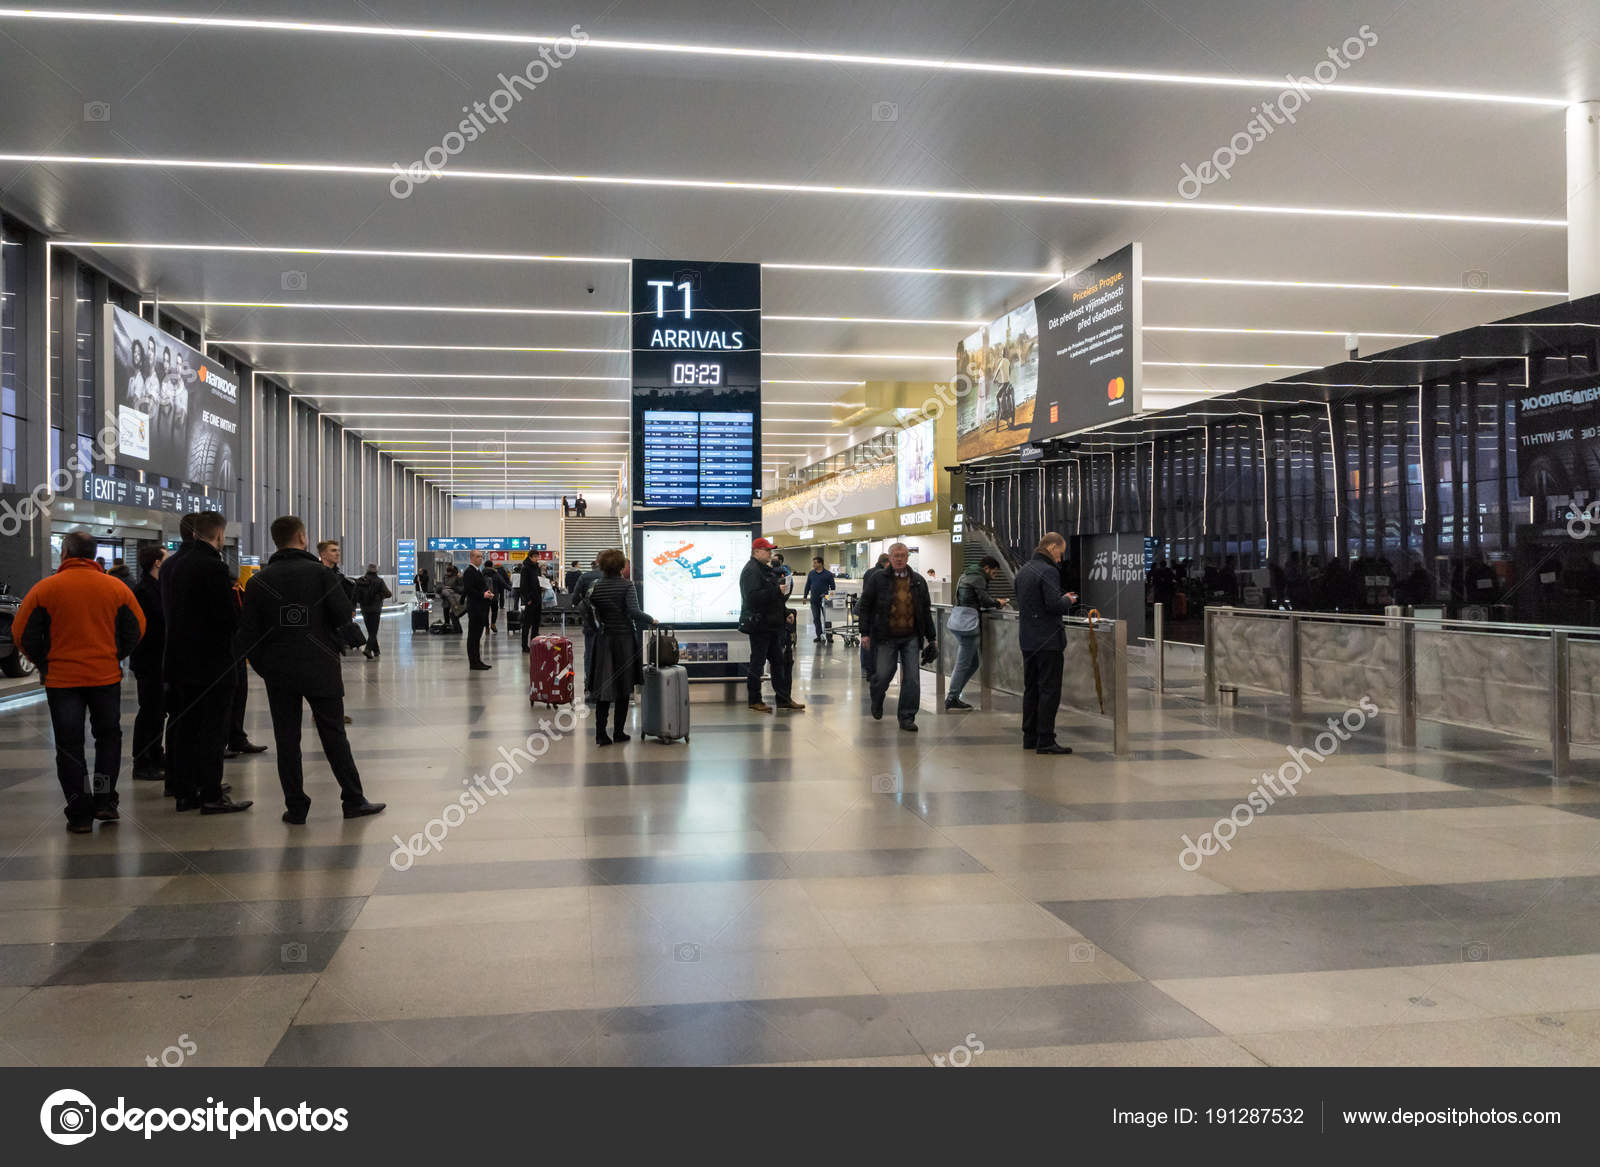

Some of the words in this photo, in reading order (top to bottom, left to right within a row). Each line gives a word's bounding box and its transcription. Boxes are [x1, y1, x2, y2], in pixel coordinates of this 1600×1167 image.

[647, 281, 691, 319] T1
[650, 329, 743, 349] ARRIVALS
[673, 364, 720, 384] 09:23
[94, 478, 117, 501] EXIT
[1111, 551, 1145, 569] Prague
